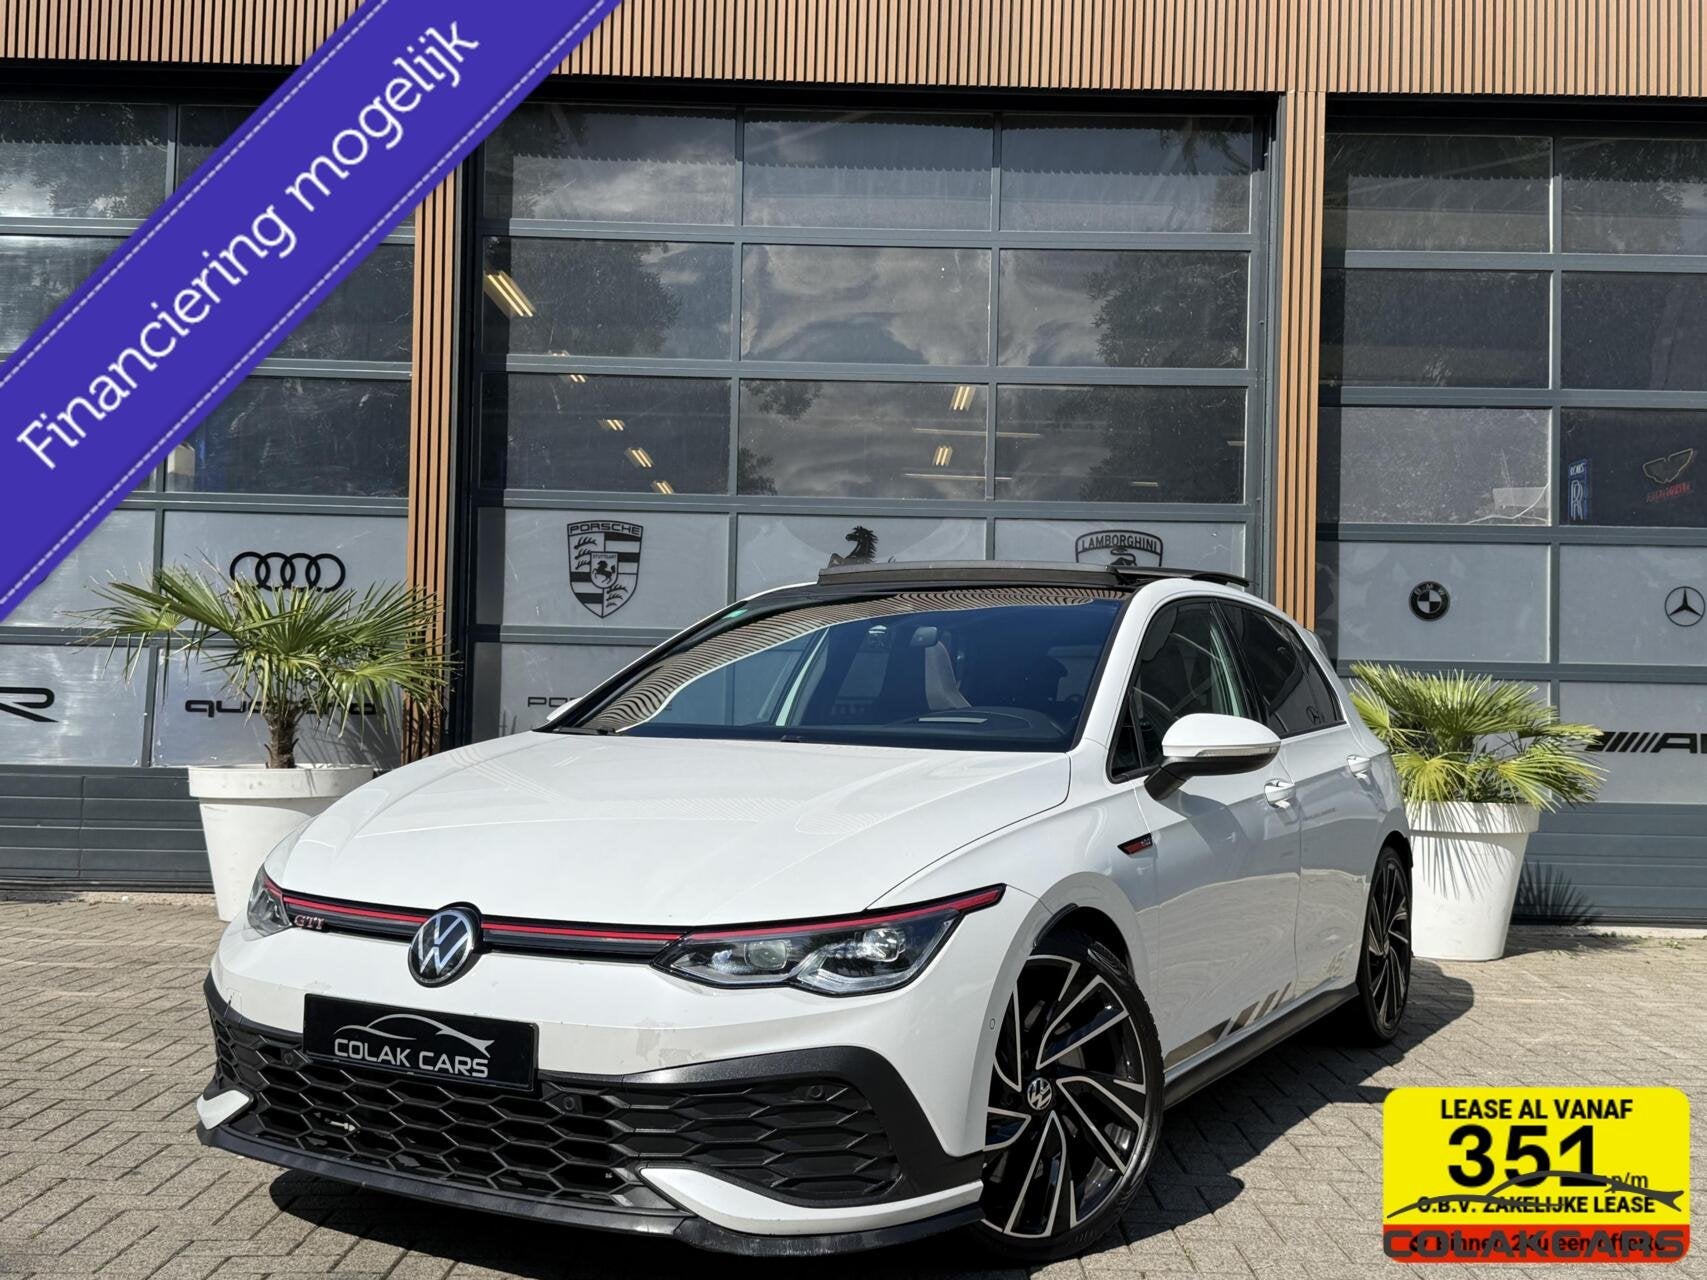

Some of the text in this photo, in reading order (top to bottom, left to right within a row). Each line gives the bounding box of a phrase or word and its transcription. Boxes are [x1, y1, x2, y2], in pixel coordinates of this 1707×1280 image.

[569, 522, 641, 537] PORSCHE
[1081, 534, 1158, 554] LAMBORGHINI
[293, 914, 326, 931] GTI
[334, 1038, 489, 1079] COLAK CARS
